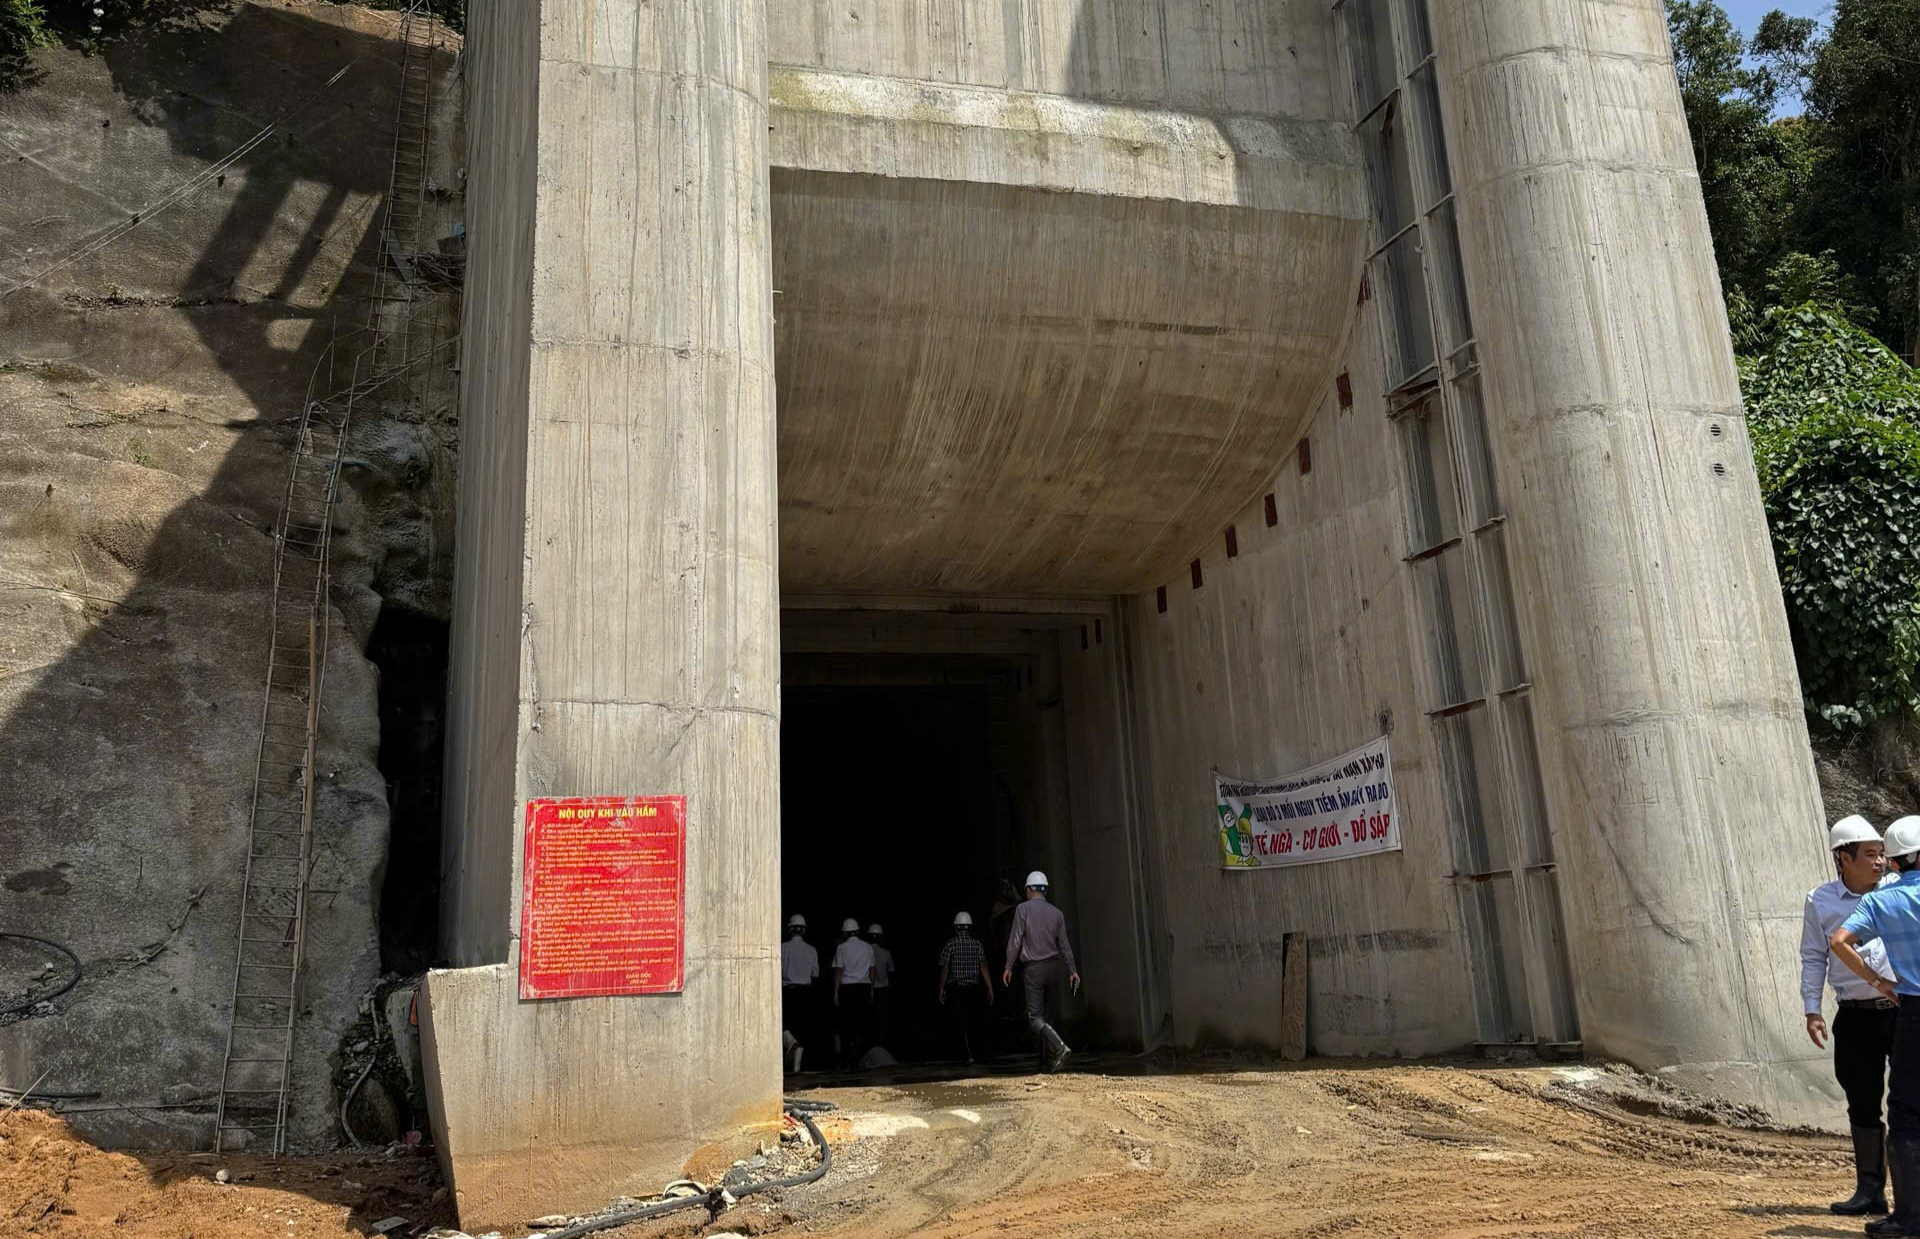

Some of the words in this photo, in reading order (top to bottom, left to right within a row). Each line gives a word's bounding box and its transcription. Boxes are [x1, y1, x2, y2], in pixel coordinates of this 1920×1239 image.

[1343, 760, 1362, 780] NẠN
[559, 807, 576, 820] NỘI
[577, 809, 595, 819] QUY
[598, 808, 614, 818] KHI
[616, 806, 634, 818] VÀO
[1274, 804, 1283, 820] 3
[1294, 799, 1317, 818] NGUY
[1365, 784, 1377, 803] RA
[1255, 830, 1268, 856] TÉ
[1270, 828, 1292, 855] NGÃ
[1303, 826, 1318, 851] CƠ
[1318, 820, 1341, 849] GIỚI
[1350, 809, 1367, 843] ĐỔ
[1370, 810, 1390, 844] SẬP
